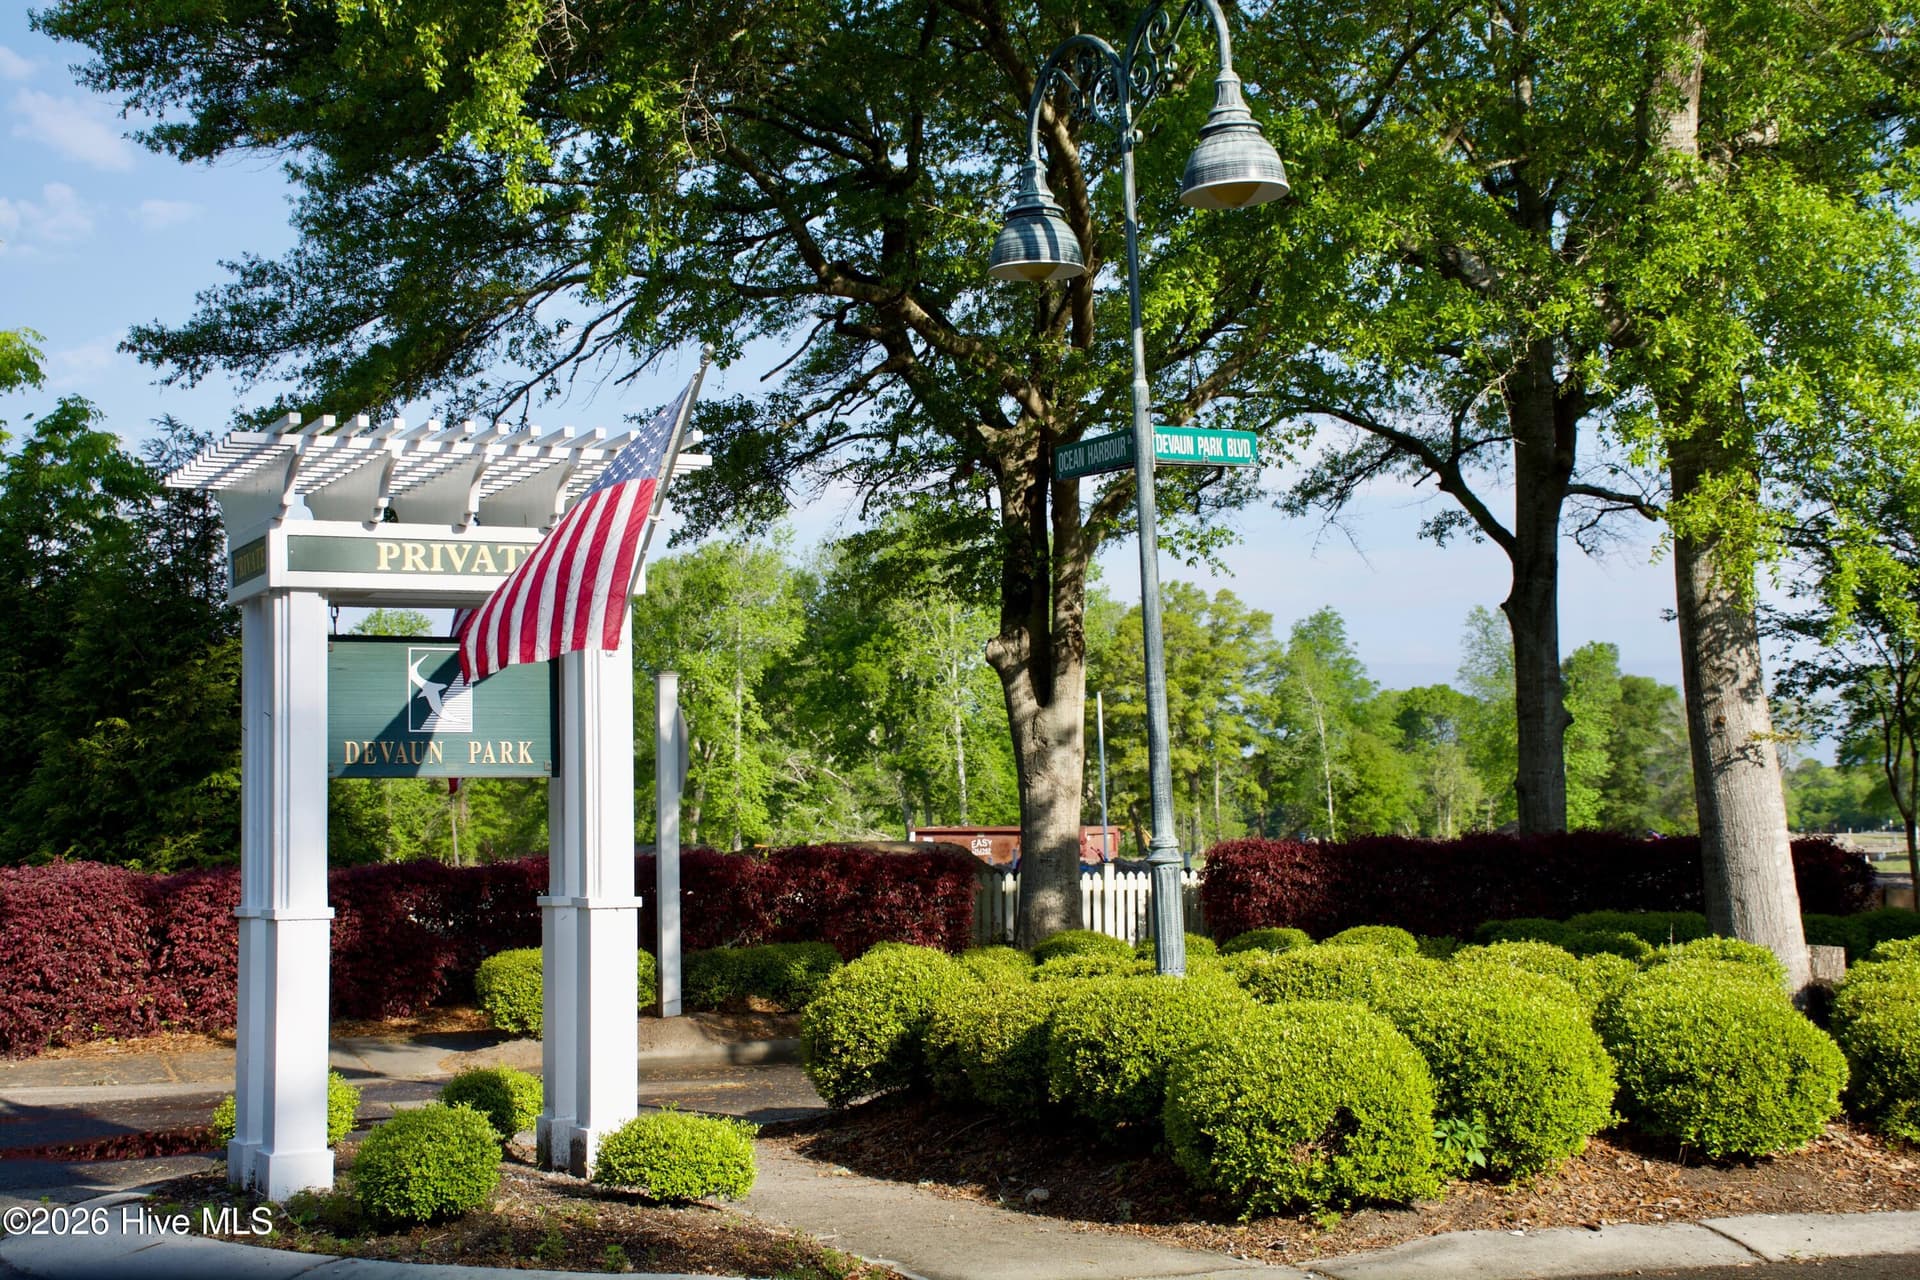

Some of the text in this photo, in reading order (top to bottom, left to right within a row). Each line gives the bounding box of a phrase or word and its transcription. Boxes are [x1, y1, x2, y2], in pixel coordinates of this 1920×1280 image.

[1058, 447, 1085, 472] OCEAN
[1087, 436, 1127, 464] HARBOUR
[1155, 433, 1194, 455] DEVAUN
[1197, 436, 1224, 457] PARK
[376, 542, 537, 574] PRIVAT
[344, 741, 534, 765] DEVAUN PARK
[971, 839, 992, 848] EASY
